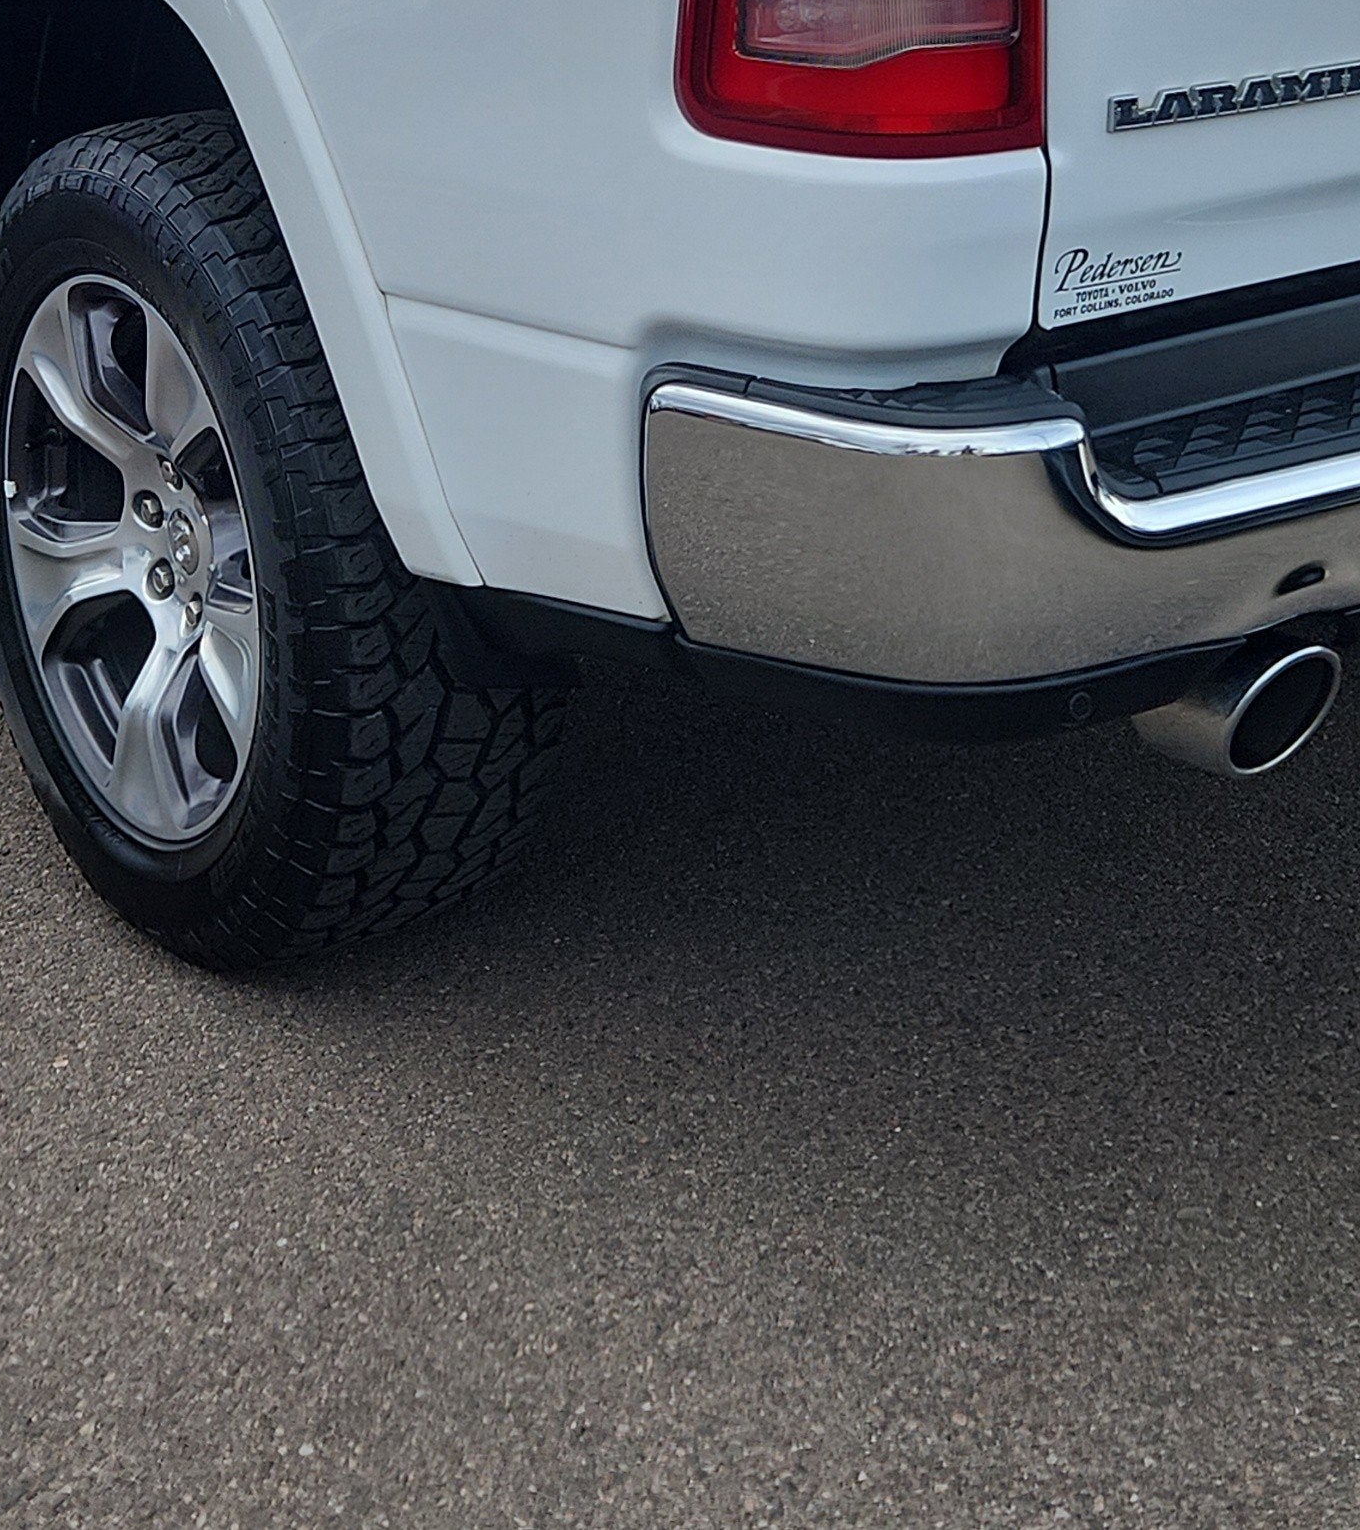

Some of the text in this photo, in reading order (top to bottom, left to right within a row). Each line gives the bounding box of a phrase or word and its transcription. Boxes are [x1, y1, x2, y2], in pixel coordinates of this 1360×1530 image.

[1054, 248, 1182, 293] Pedersen
[1053, 306, 1078, 319] FORT
[1125, 288, 1174, 305] COLORADO
[1075, 279, 1156, 303] TOYOTA VOLVO
